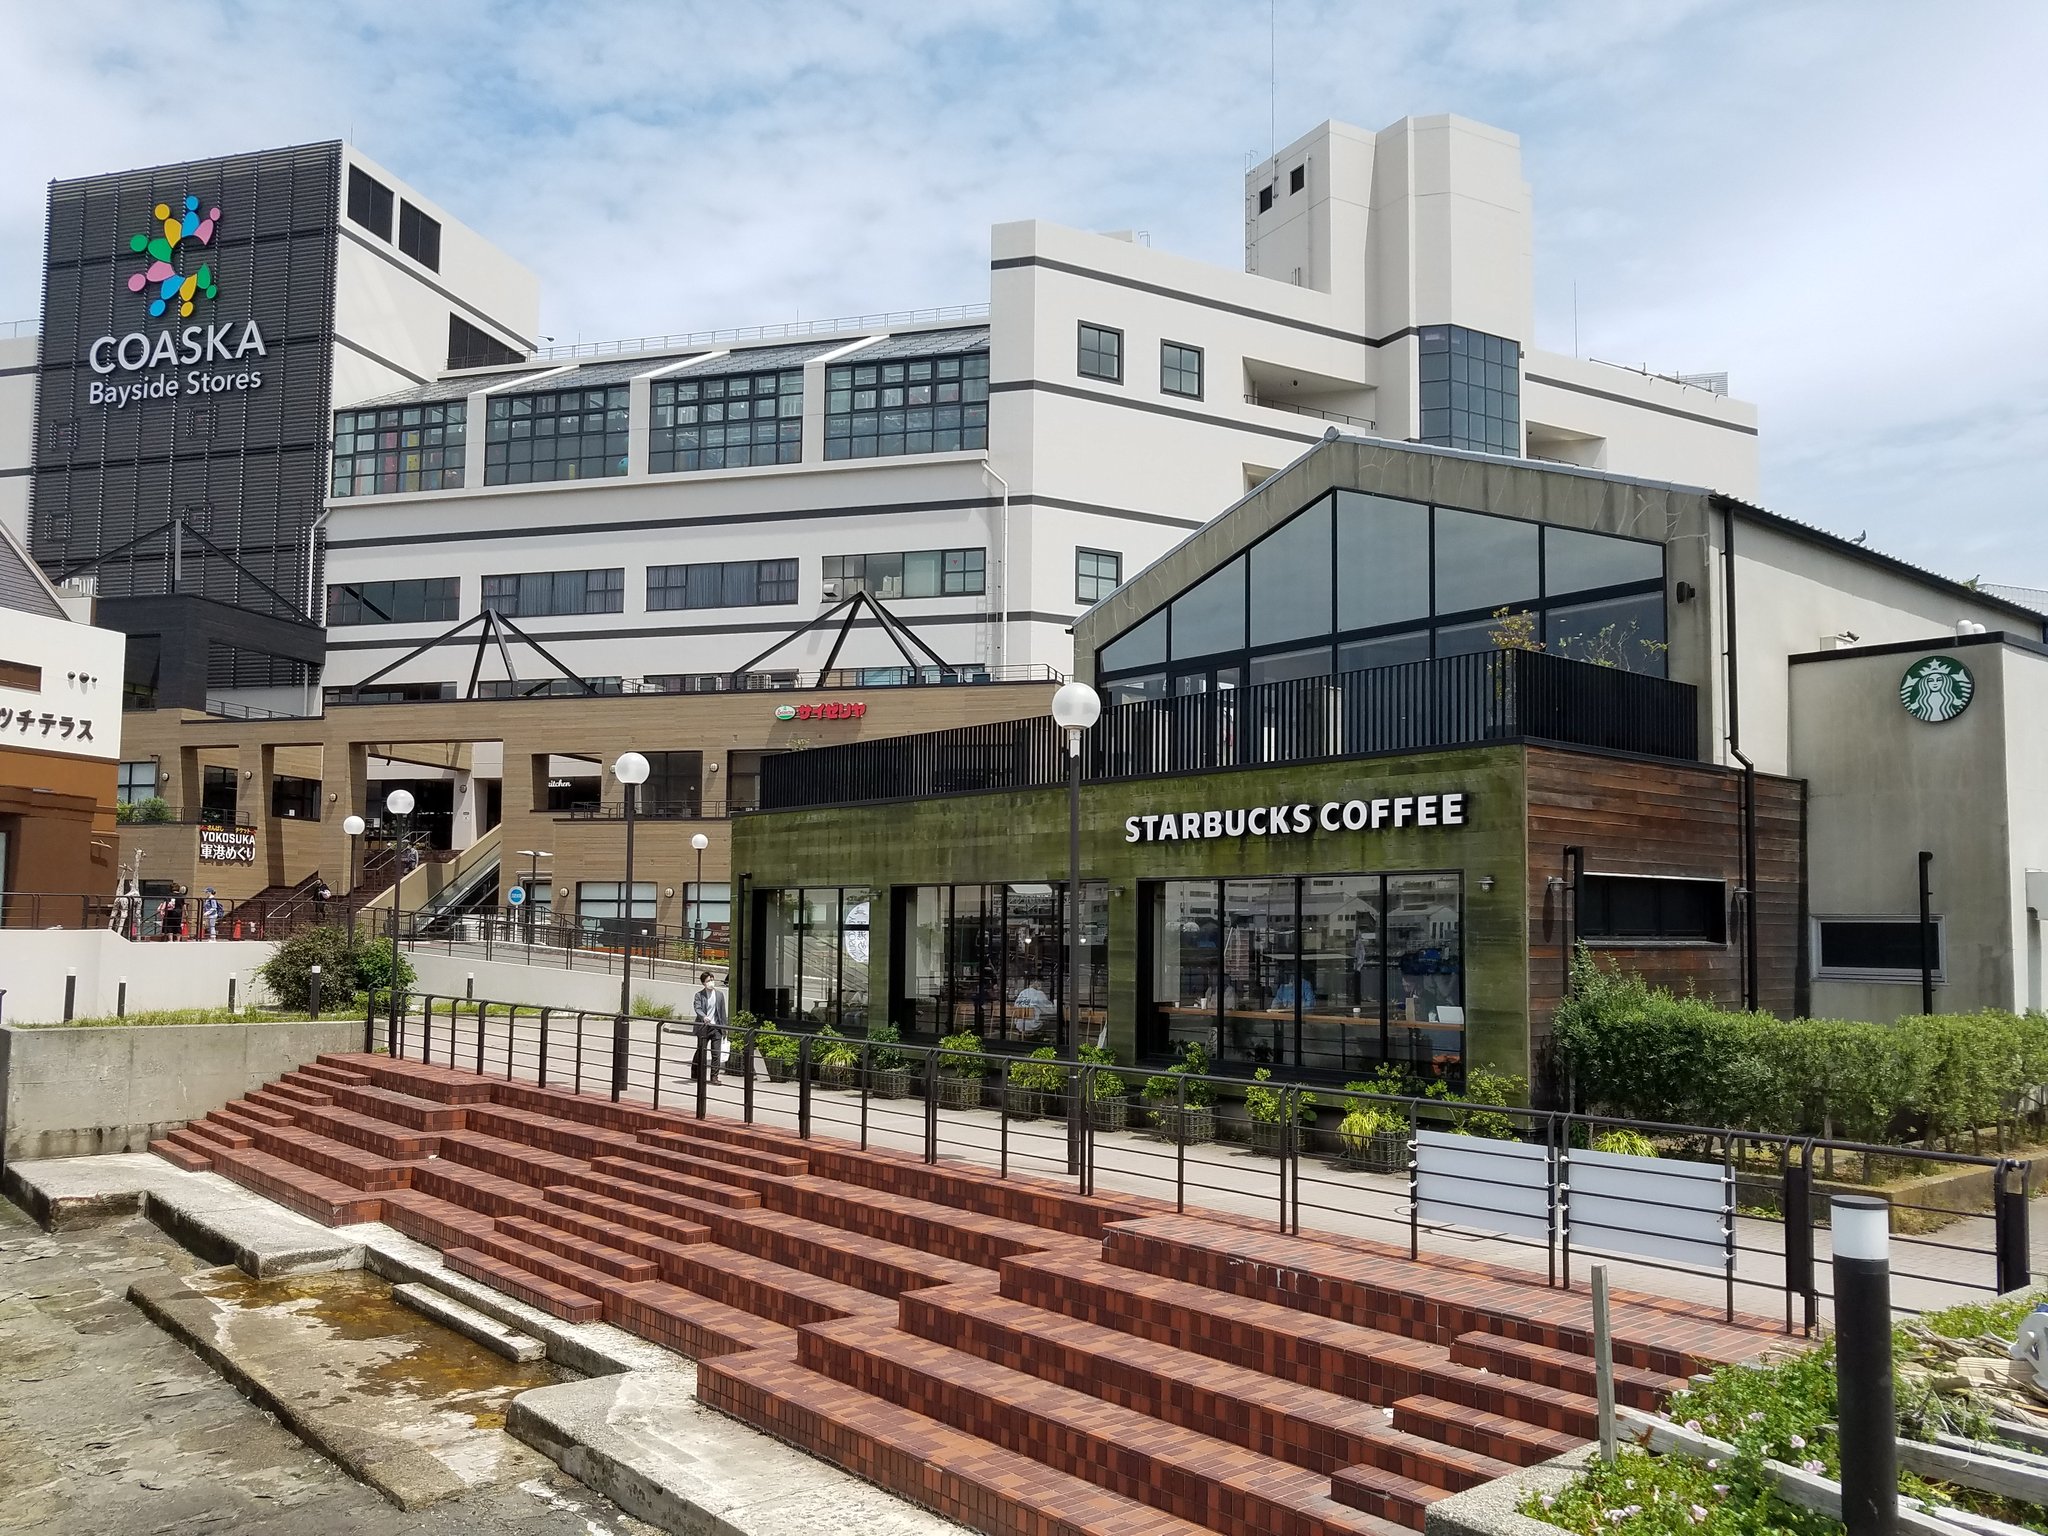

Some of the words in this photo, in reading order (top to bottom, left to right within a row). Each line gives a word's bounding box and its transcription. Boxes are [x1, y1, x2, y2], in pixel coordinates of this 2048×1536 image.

[89, 320, 267, 374] COASKA
[89, 373, 179, 409] Bayside
[186, 370, 262, 395] Stores
[798, 701, 867, 720] サイゼリヤ
[1125, 804, 1311, 843] STARBUCKS
[1320, 793, 1464, 831] COFFEE
[200, 843, 256, 861] 軍港めぐり
[202, 831, 256, 845] YOKOSUKA
